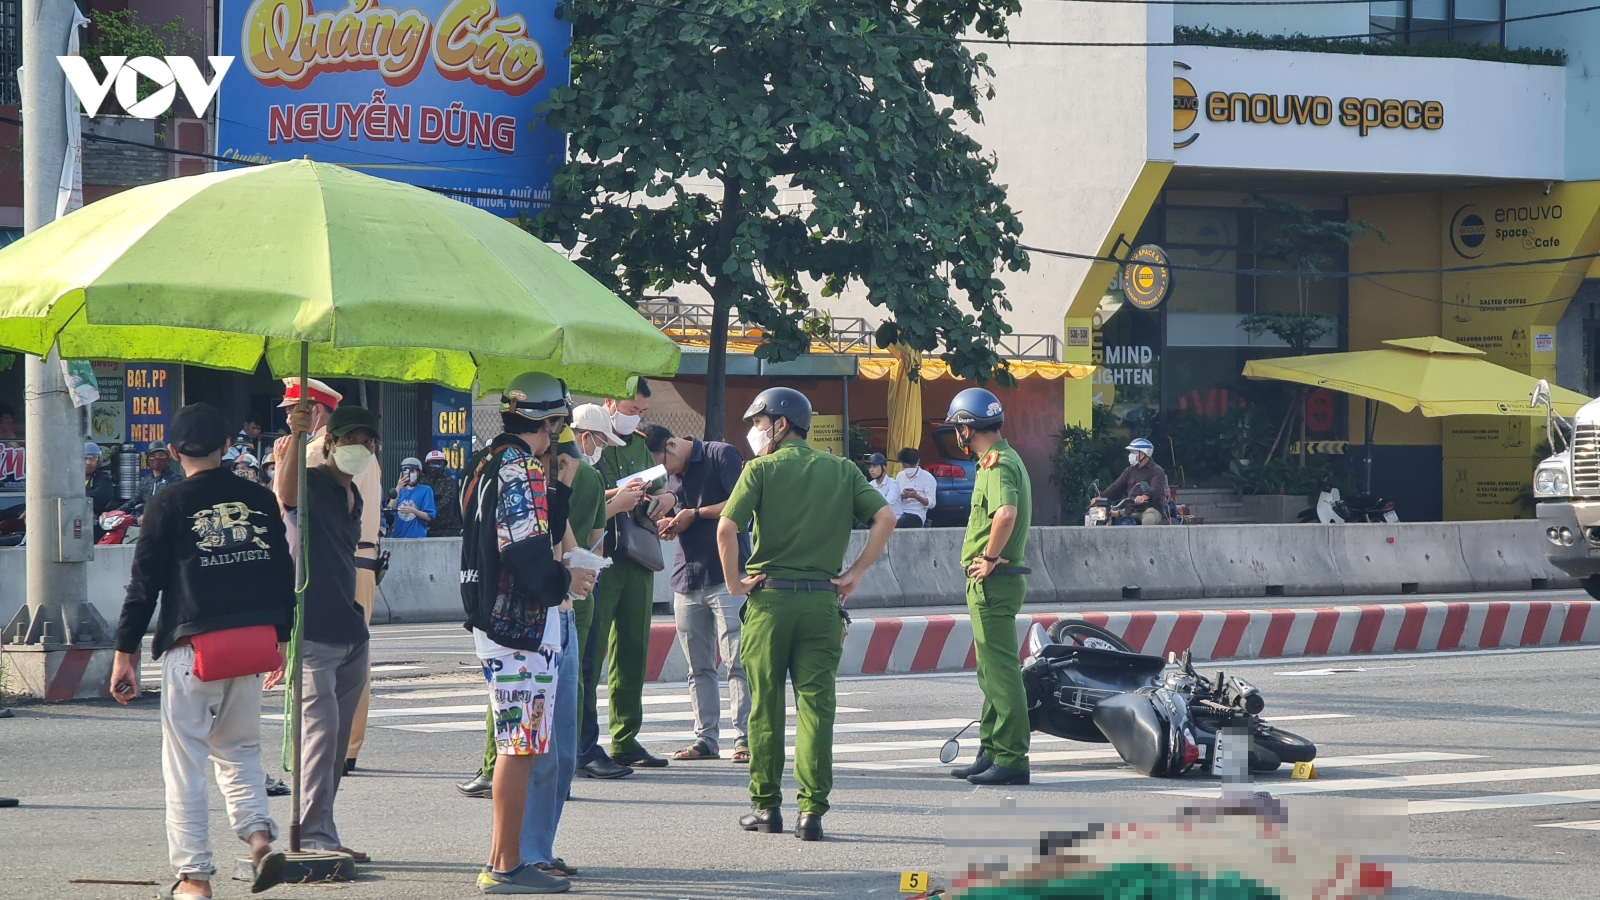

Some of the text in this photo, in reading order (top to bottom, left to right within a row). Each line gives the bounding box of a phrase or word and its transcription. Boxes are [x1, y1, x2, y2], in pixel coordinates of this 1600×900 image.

[1173, 97, 1199, 109] ouvo
[268, 90, 516, 155] NGUYỄN DŨNG
[1206, 91, 1444, 137] enouvo space
[1495, 205, 1562, 222] enouvo
[1495, 228, 1528, 240] Space
[1534, 236, 1560, 247] Cafe
[1138, 249, 1155, 258] SPACE
[1105, 345, 1153, 364] MIND
[132, 397, 162, 415] DEAL
[439, 407, 467, 434] CHỮ
[131, 424, 164, 442] MENU
[200, 550, 271, 567] BAILVISTA
[1298, 763, 1306, 775] 6
[909, 873, 919, 888] 5
